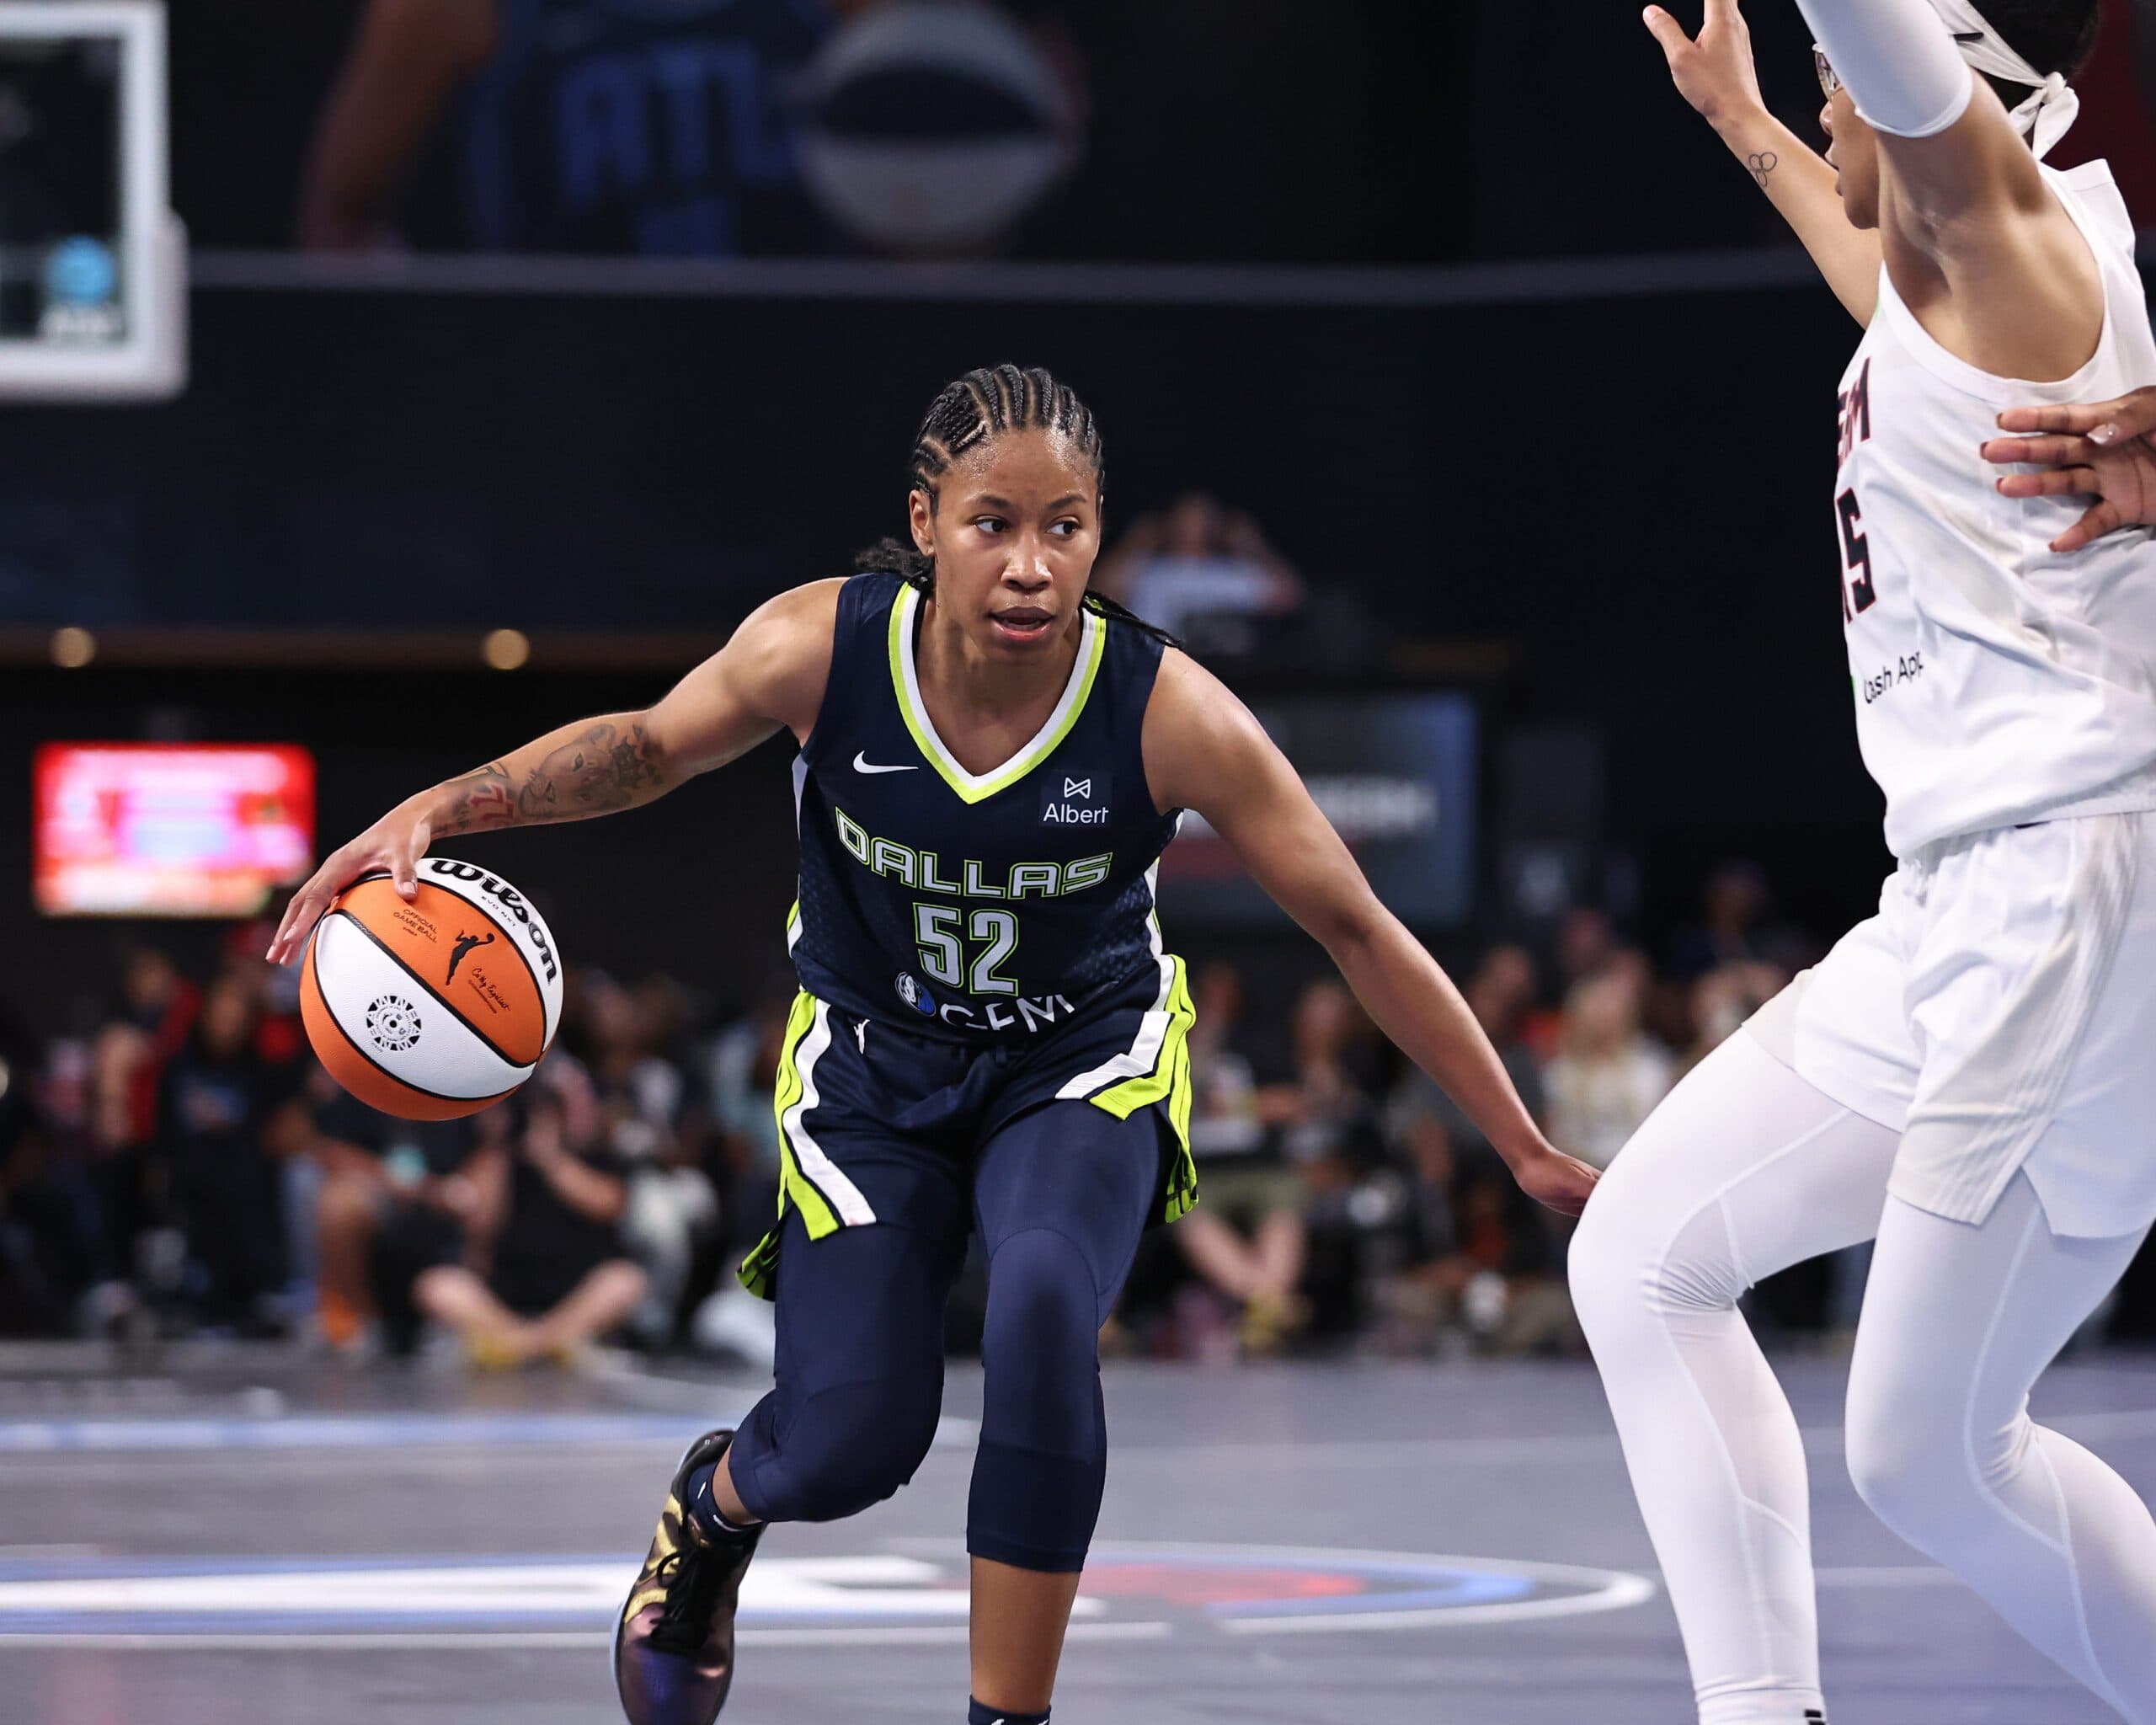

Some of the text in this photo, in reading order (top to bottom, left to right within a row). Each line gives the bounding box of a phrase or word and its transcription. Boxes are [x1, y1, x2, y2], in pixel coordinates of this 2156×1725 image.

[1043, 803, 1109, 825] Albert
[835, 806, 1113, 900] DALLAS
[393, 911, 419, 929] GAME
[417, 925, 438, 944] BALL
[403, 909, 438, 934] OFFICIAL
[912, 902, 1019, 997] 52
